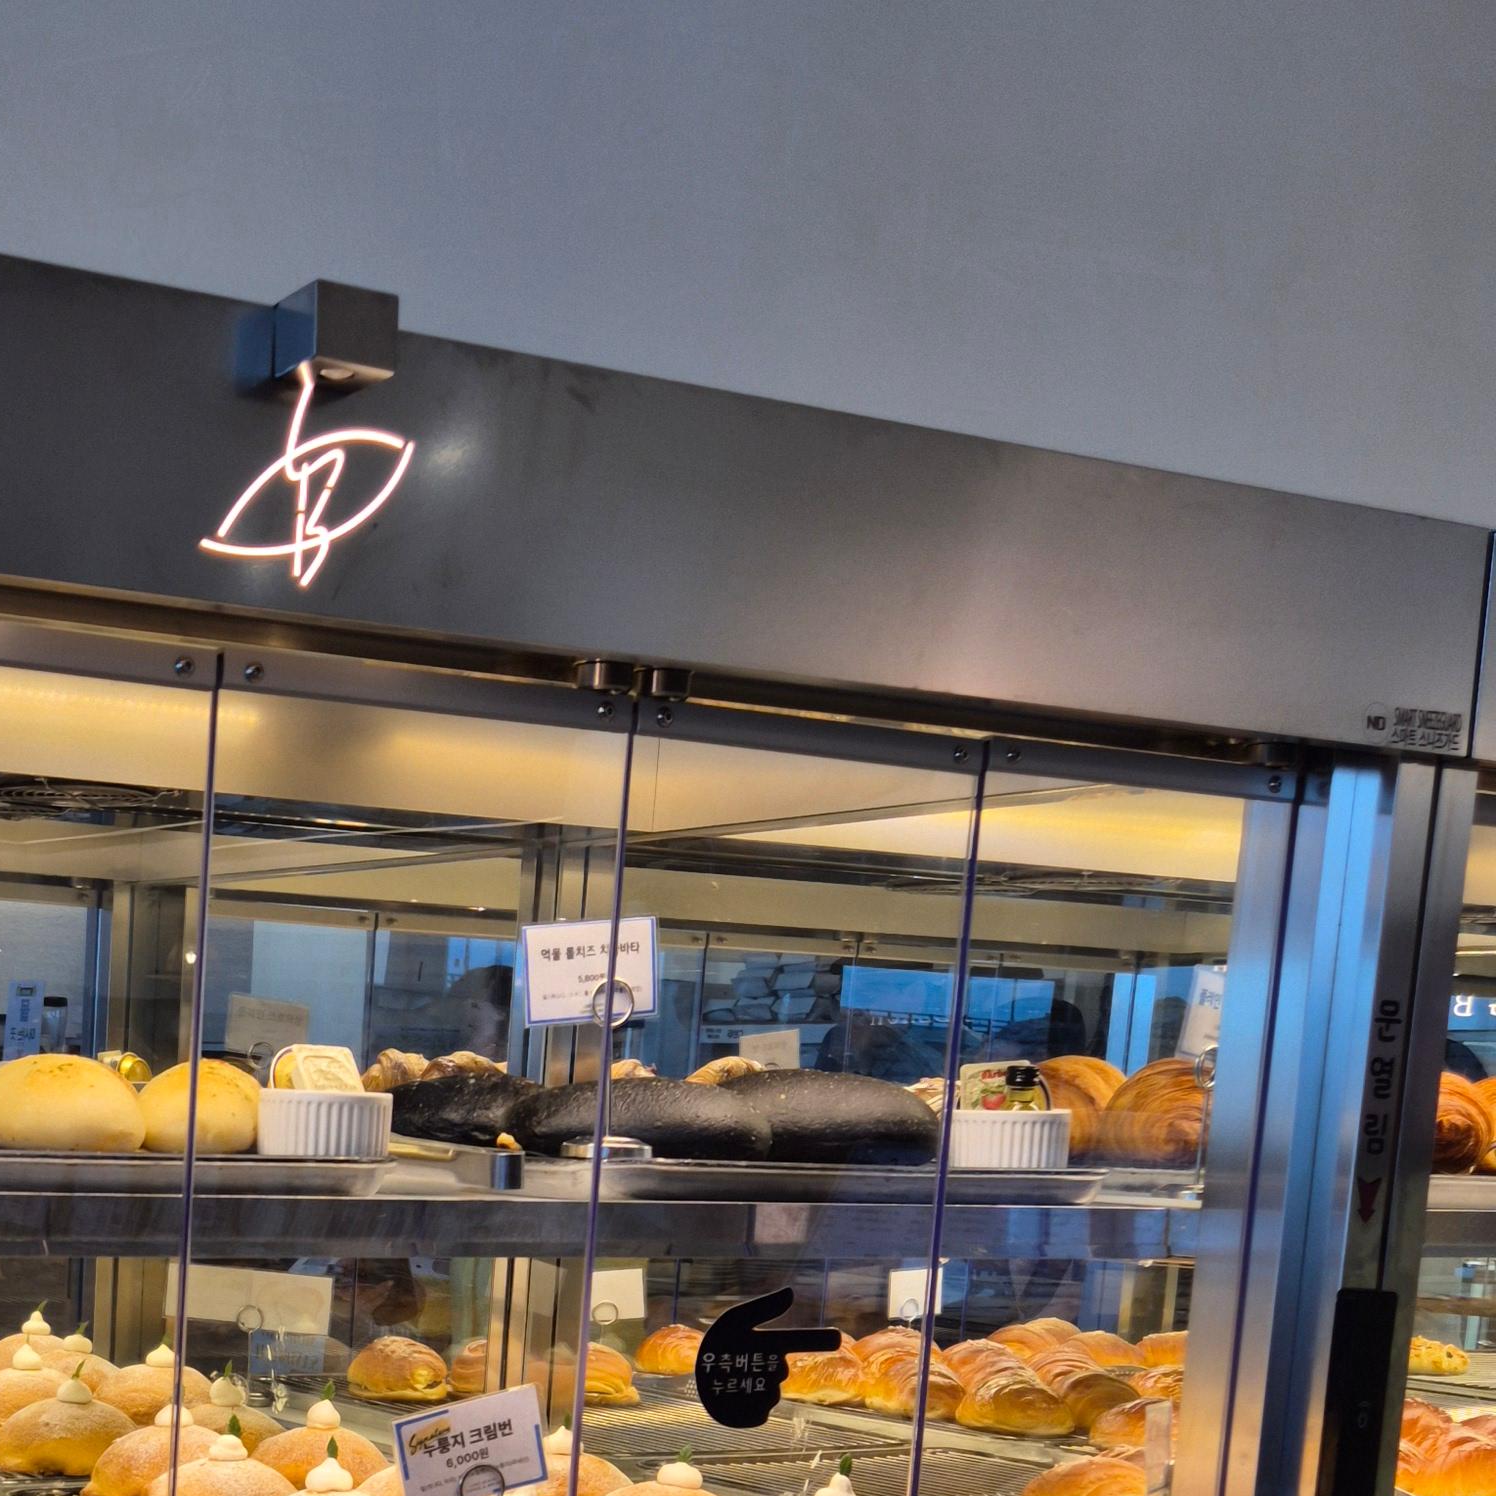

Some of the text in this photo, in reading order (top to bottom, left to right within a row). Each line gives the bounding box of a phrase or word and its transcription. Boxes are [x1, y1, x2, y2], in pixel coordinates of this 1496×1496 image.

[599, 941, 641, 956] 치바타
[701, 1353, 779, 1374] 우측버튼을
[711, 1378, 766, 1396] 누르세요
[423, 1418, 514, 1458] 누룽지 크림번
[446, 1447, 490, 1469] 6,000원
